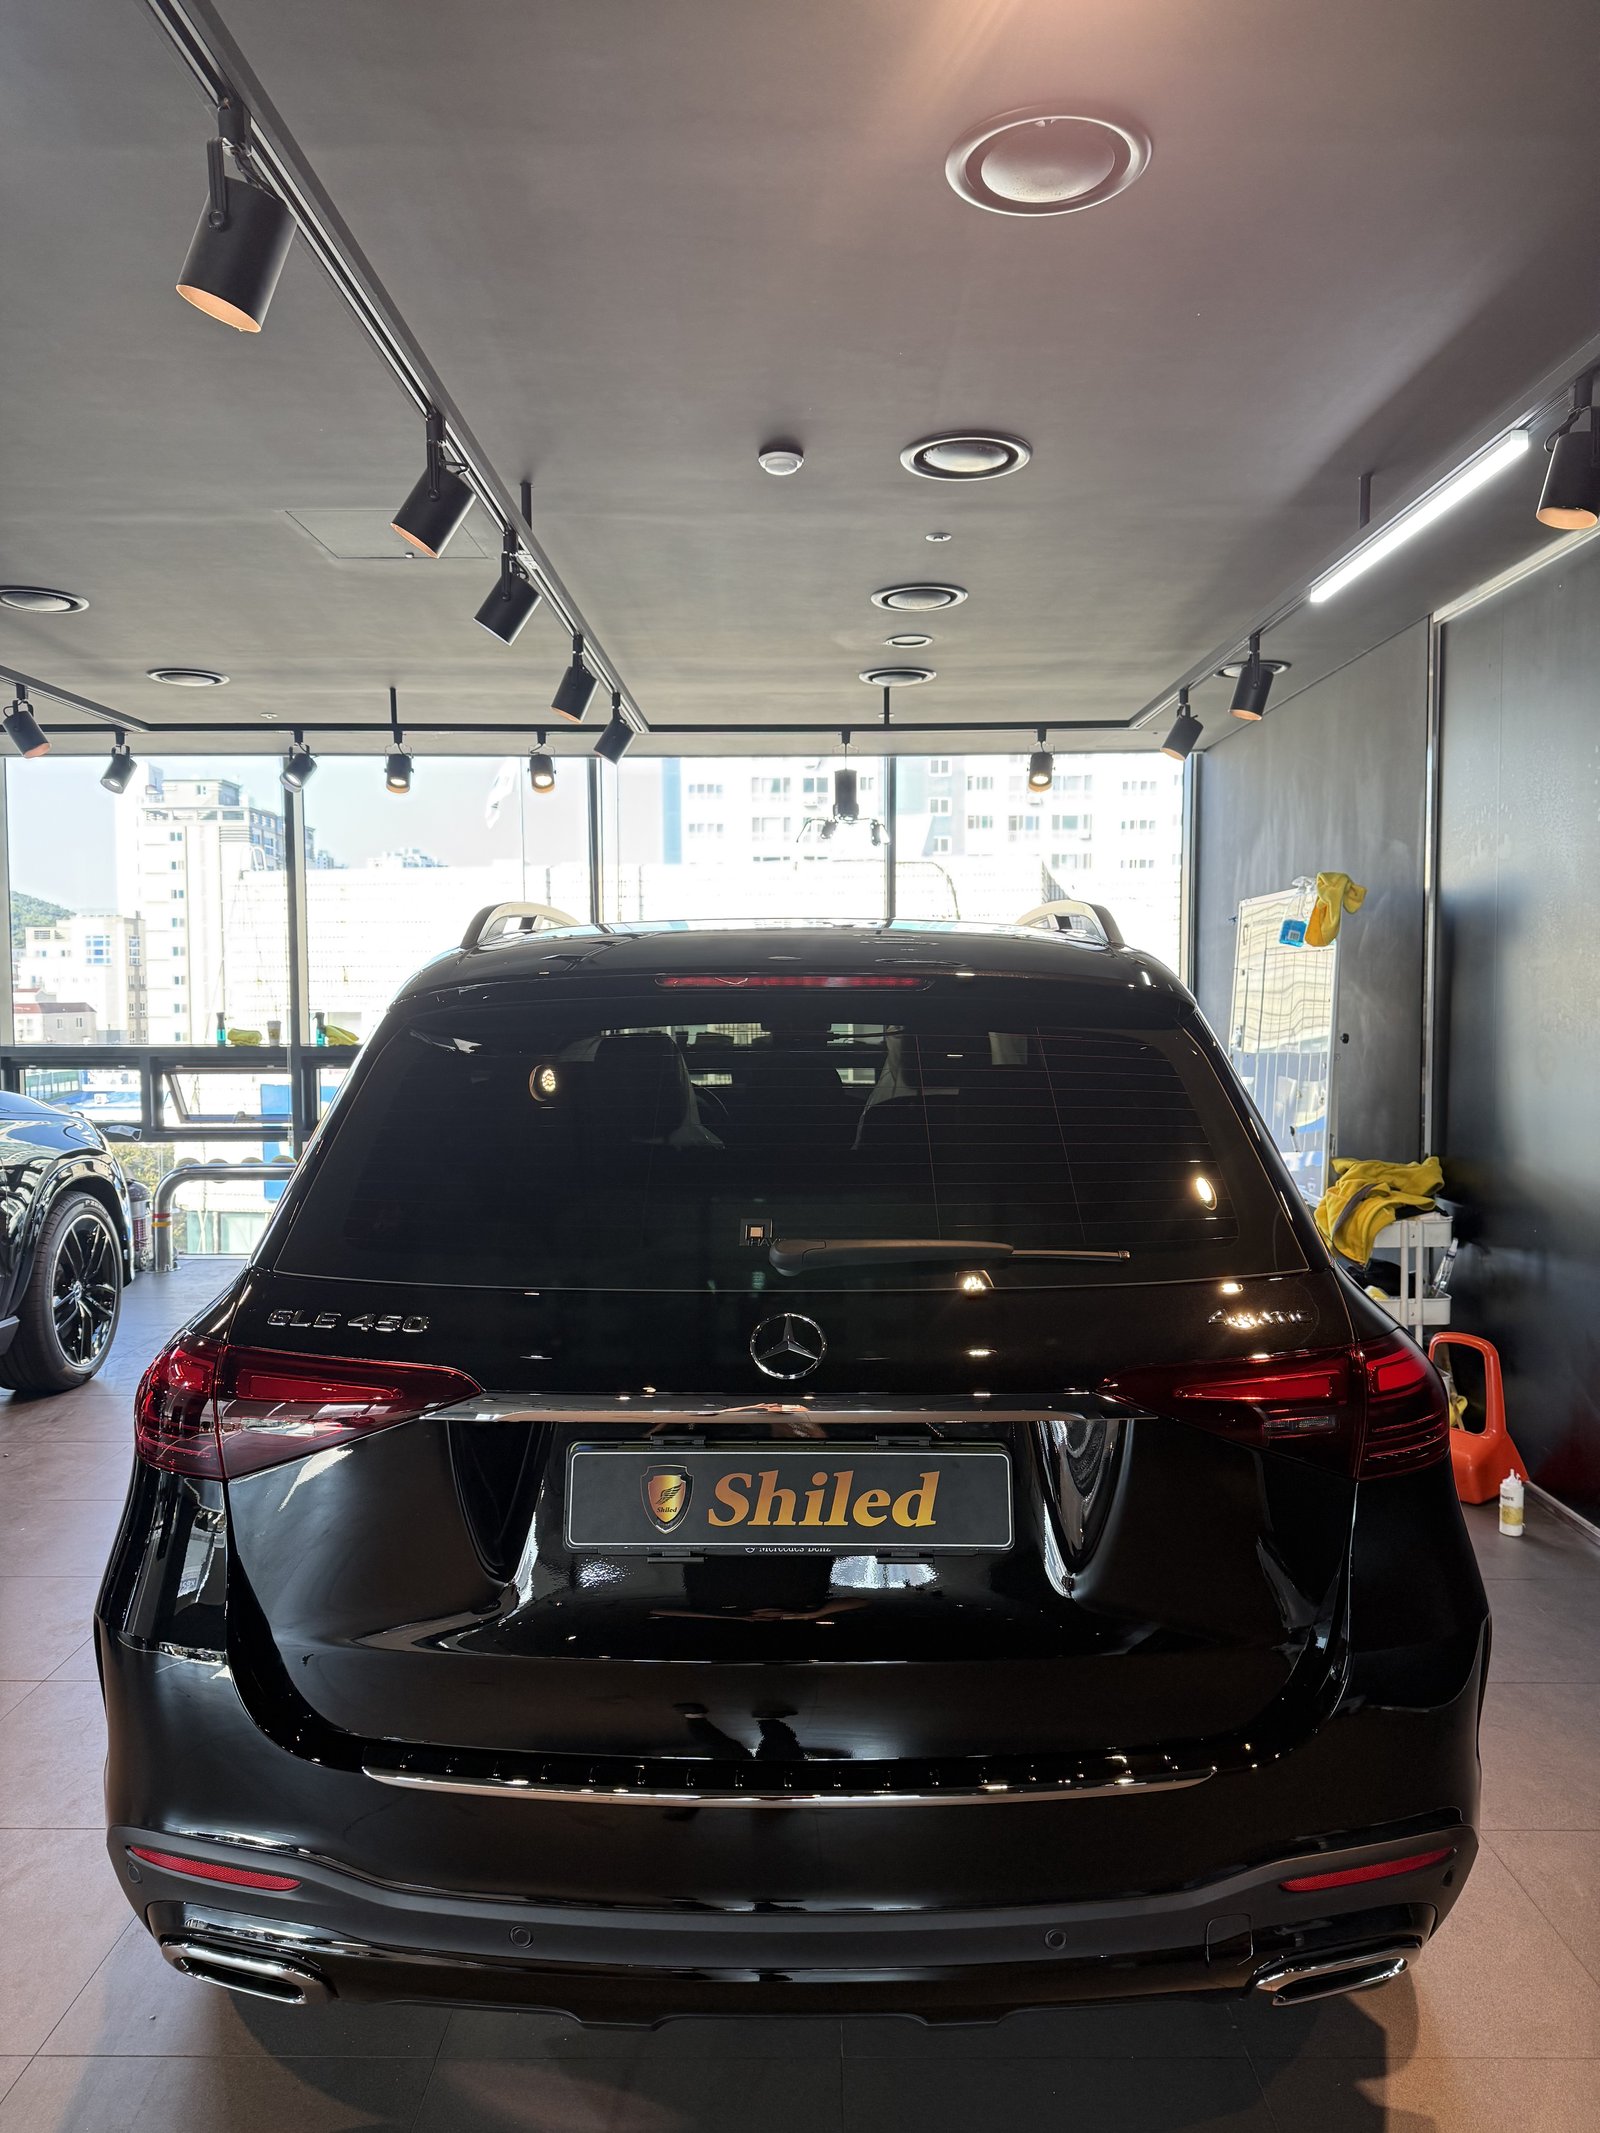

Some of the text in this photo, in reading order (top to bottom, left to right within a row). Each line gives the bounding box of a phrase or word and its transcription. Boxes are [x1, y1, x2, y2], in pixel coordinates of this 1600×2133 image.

[267, 1309, 430, 1333] GLE 450
[708, 1470, 941, 1528] Shiled
